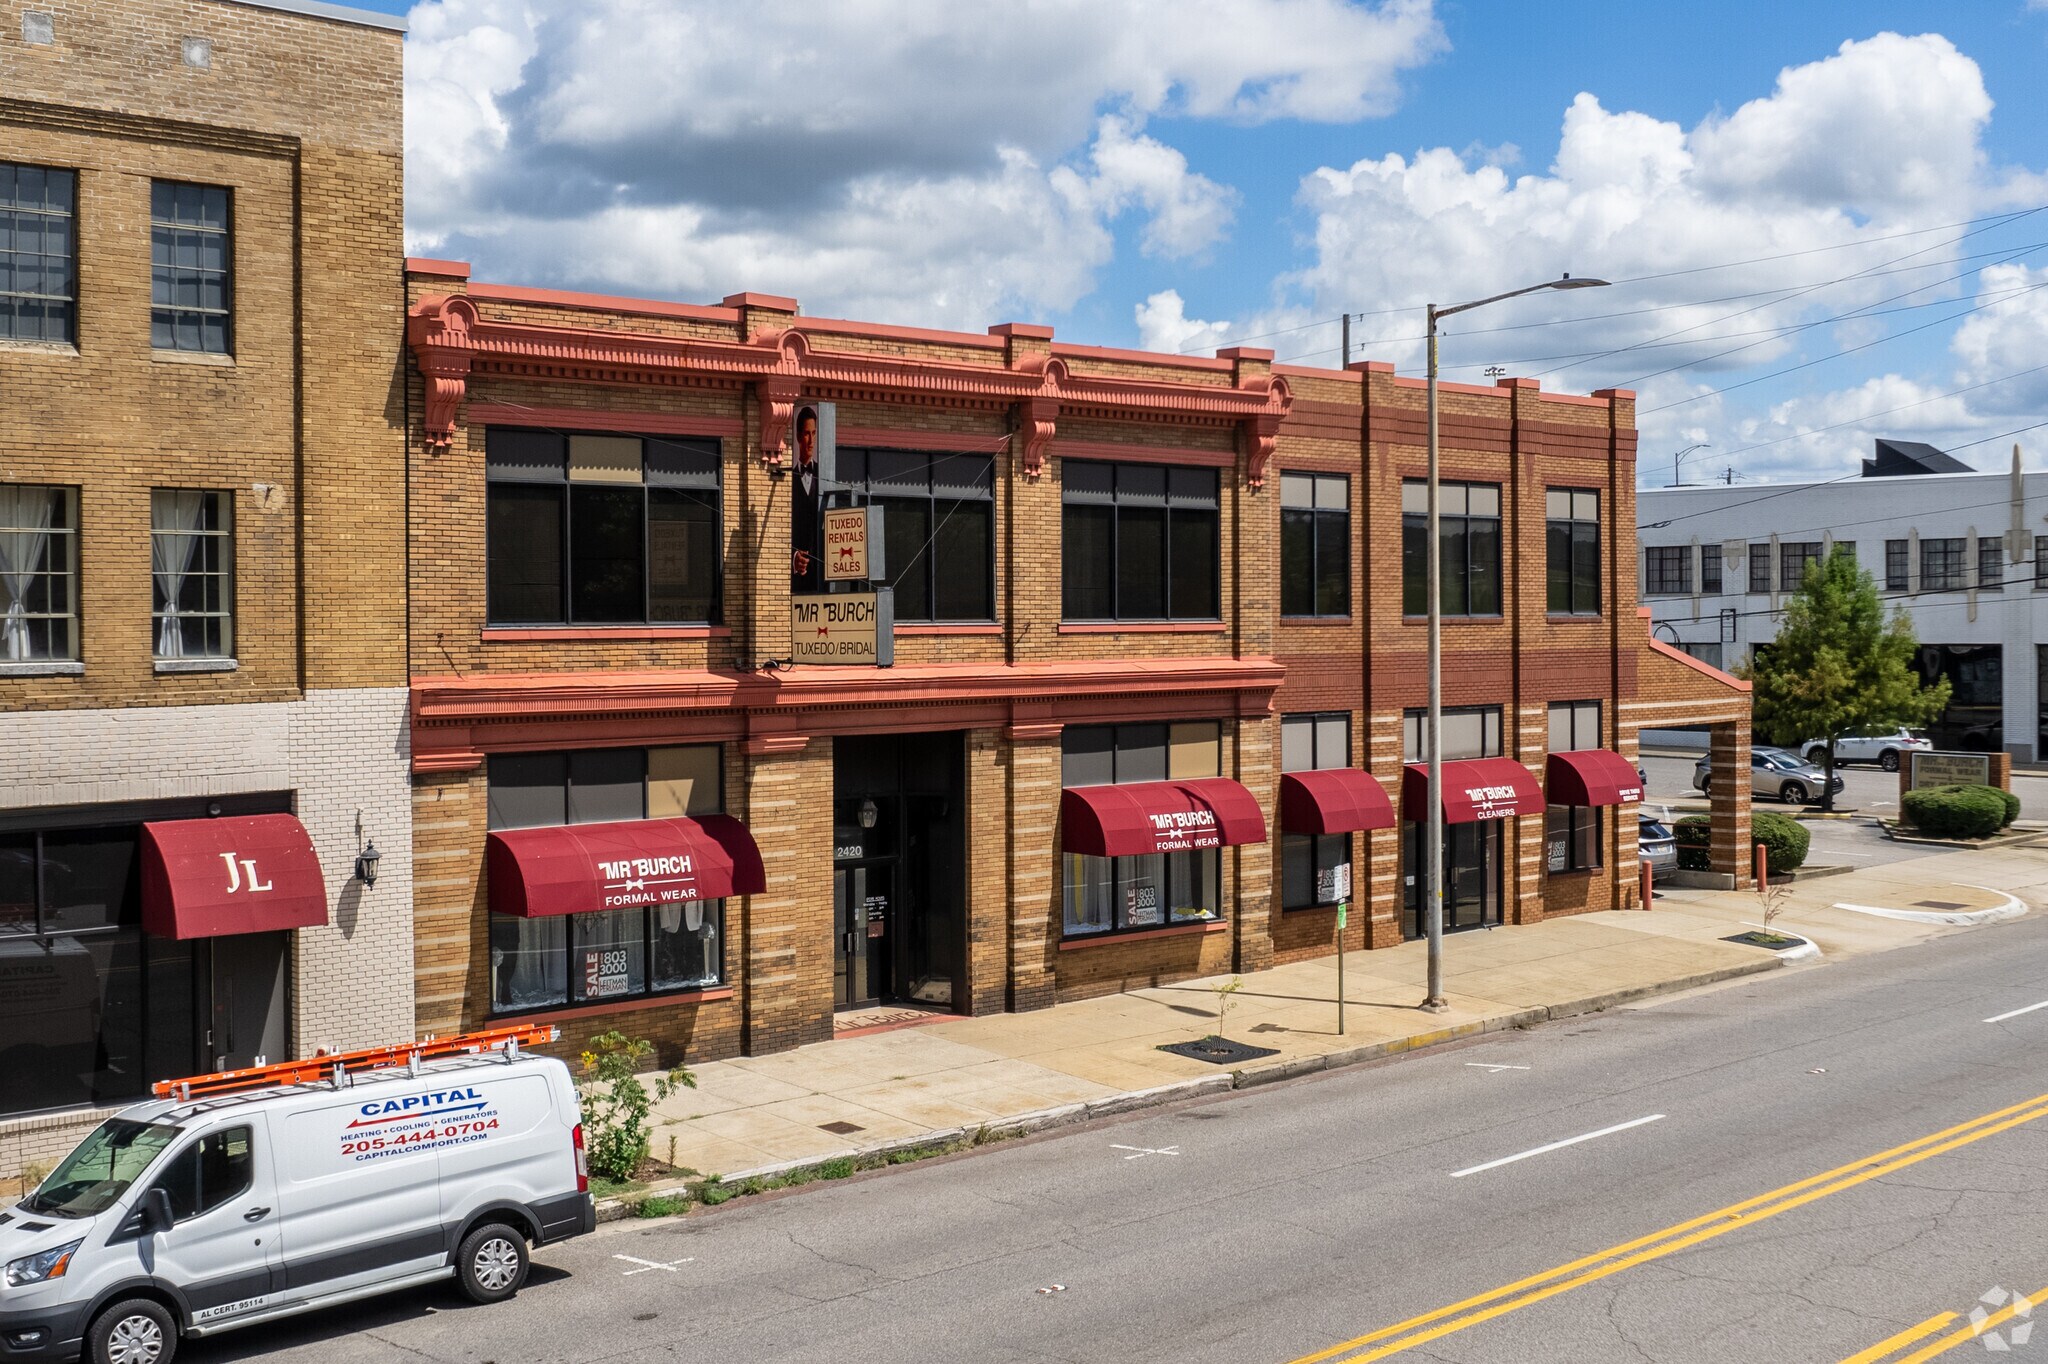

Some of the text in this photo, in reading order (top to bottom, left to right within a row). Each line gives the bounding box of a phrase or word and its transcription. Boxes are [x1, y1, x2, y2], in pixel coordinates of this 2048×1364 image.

[829, 517, 863, 530] TUXEDO
[828, 531, 864, 544] RENTALS
[833, 561, 860, 573] SALES
[794, 601, 875, 623] MR BURCH
[795, 641, 875, 655] TUXEDO/BRIDAL
[1465, 785, 1516, 801] MR BURCH
[1149, 810, 1215, 829] MR BURCH
[1477, 808, 1515, 819] CLEANERS
[837, 845, 862, 857] 2420
[1156, 837, 1219, 850] FORMAL WEAR
[598, 855, 692, 880] MR BURCH
[605, 888, 697, 907] FORMAL WEAR
[1137, 897, 1156, 908] 3000
[1128, 888, 1137, 925] SALE
[604, 950, 627, 965] 803
[586, 952, 598, 997] SALE
[600, 962, 627, 976] 3000
[361, 1088, 482, 1116] CAPITAL
[341, 1110, 498, 1141] HEATING COOLING GENERATORS
[341, 1118, 499, 1155] 205-444-0704
[356, 1133, 487, 1161] CAPITALCOMFORT.COM
[201, 1297, 264, 1319] AL CERT. 95114
